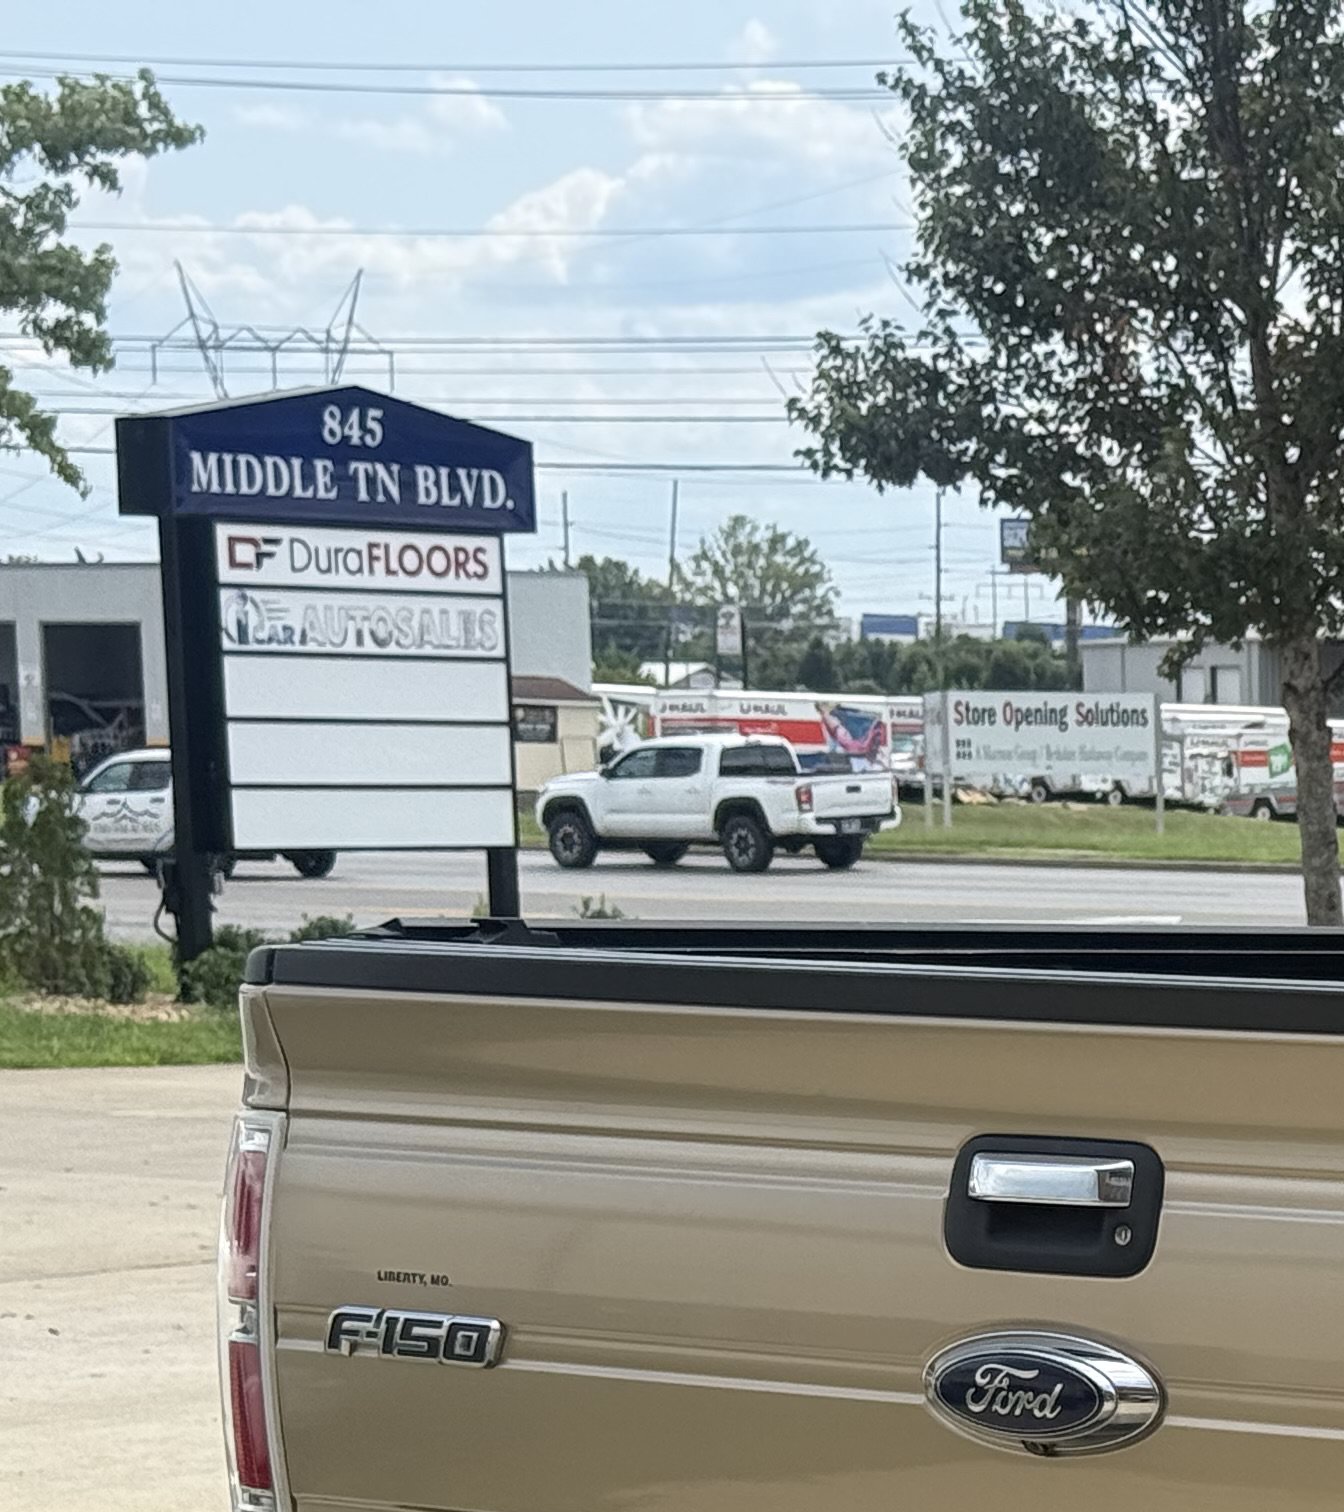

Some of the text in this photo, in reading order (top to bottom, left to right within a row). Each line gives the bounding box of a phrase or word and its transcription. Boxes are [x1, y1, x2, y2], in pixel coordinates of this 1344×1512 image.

[321, 405, 384, 448] 845
[190, 450, 515, 511] MIDDLE TN BLVD.
[289, 537, 490, 581] DuraFLOORS
[953, 700, 997, 727] Store
[1003, 702, 1070, 733] Opening
[1075, 701, 1149, 728] Solutions
[377, 1270, 428, 1287] LIBERTY,
[325, 1304, 505, 1369] F-150
[965, 1363, 1063, 1419] Ford
